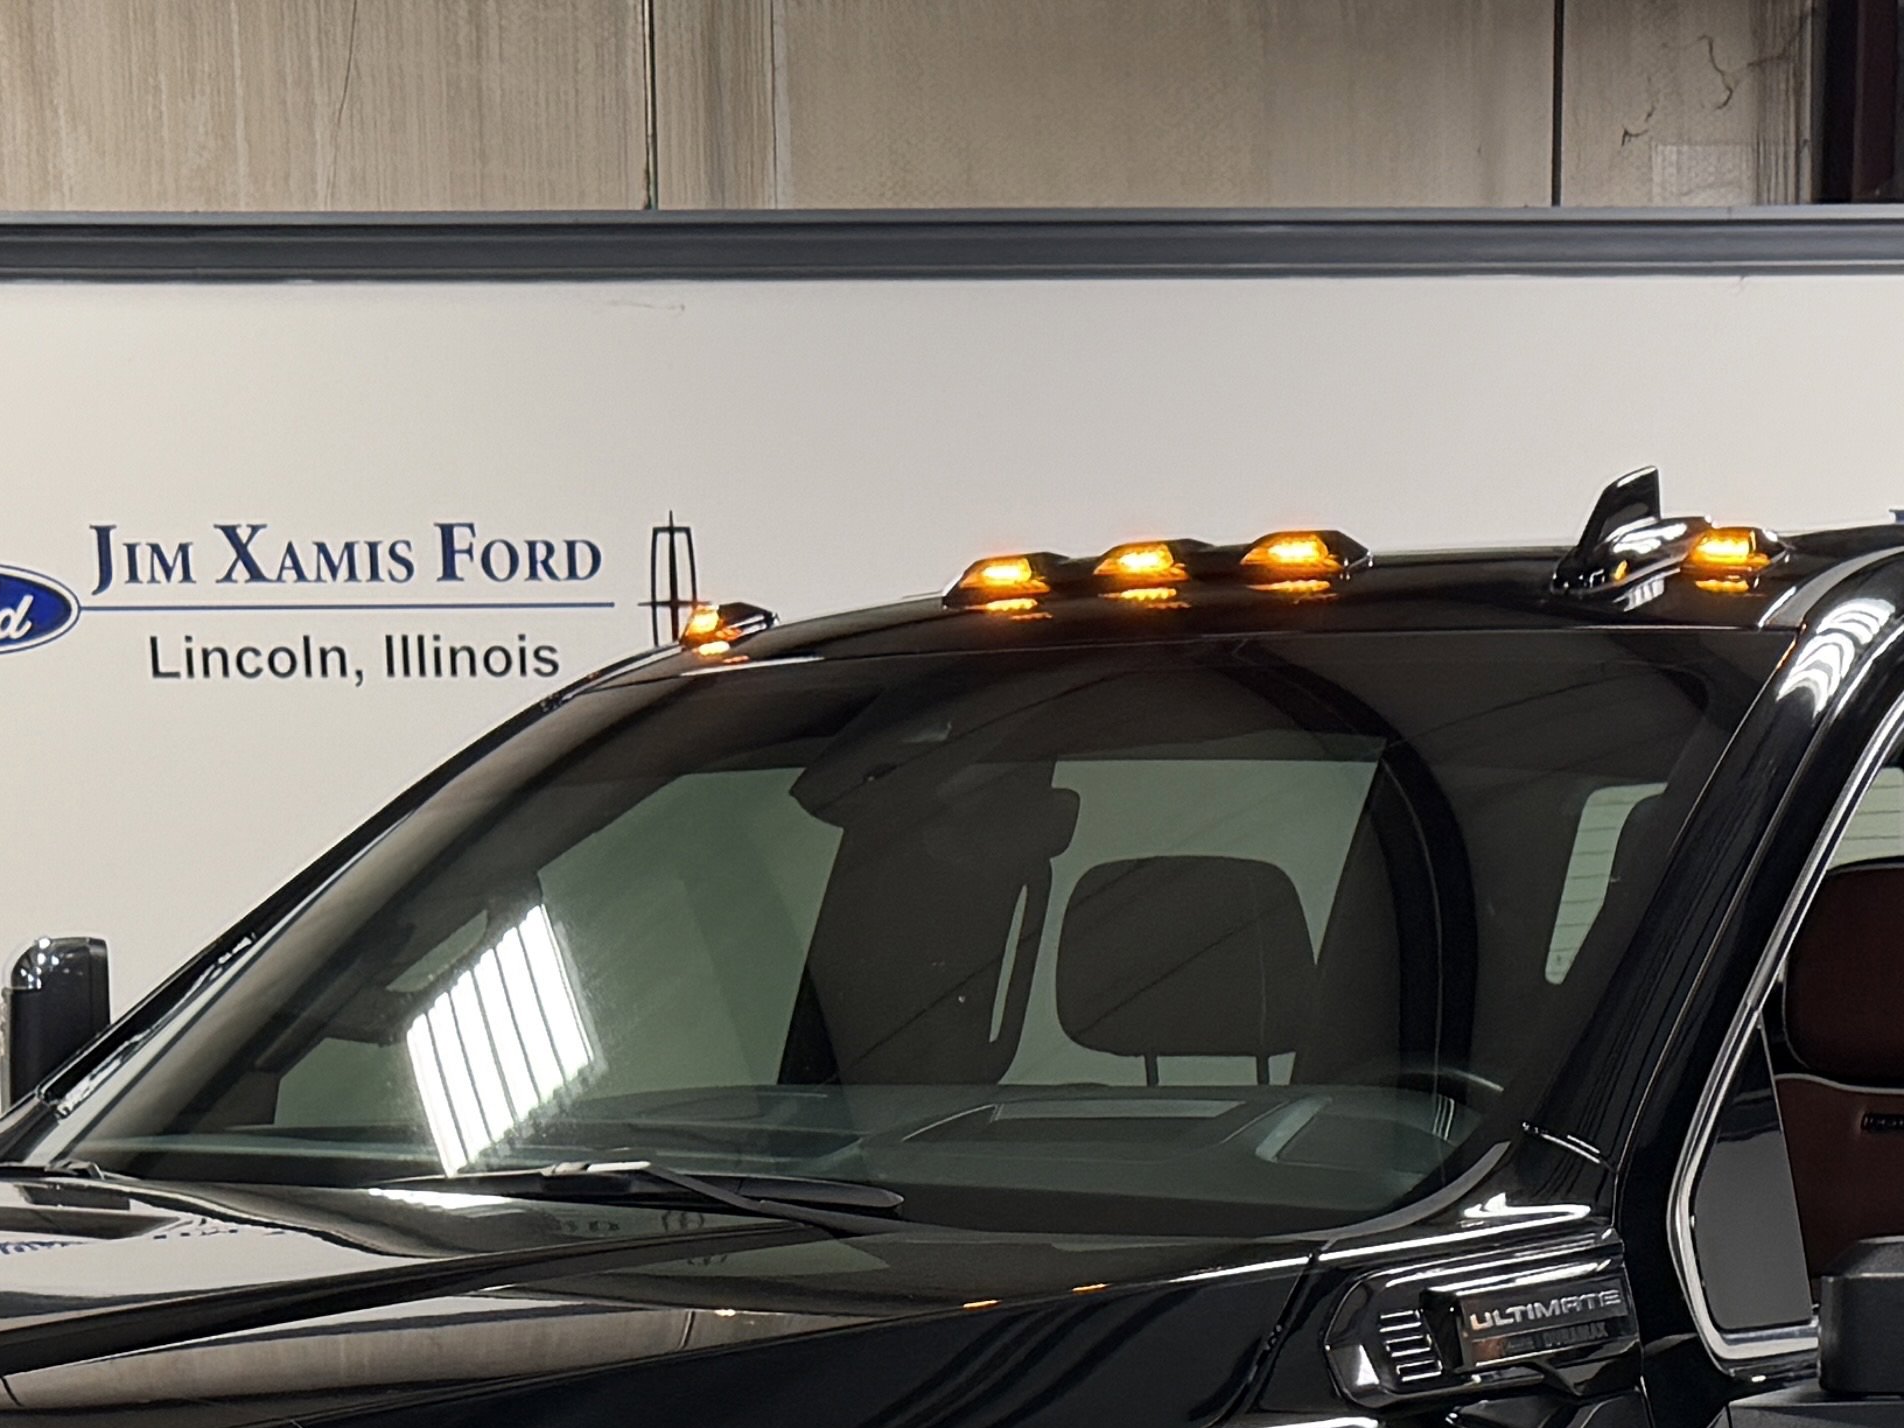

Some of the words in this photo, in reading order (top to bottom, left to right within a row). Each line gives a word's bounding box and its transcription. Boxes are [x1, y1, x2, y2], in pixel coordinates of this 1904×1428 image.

[88, 522, 193, 596] JIM
[212, 522, 415, 585] XAMIS
[434, 521, 603, 584] FORD
[149, 634, 364, 687] Lincoln,
[385, 633, 561, 680] Illinois
[1469, 1289, 1622, 1331] ULTIMATE
